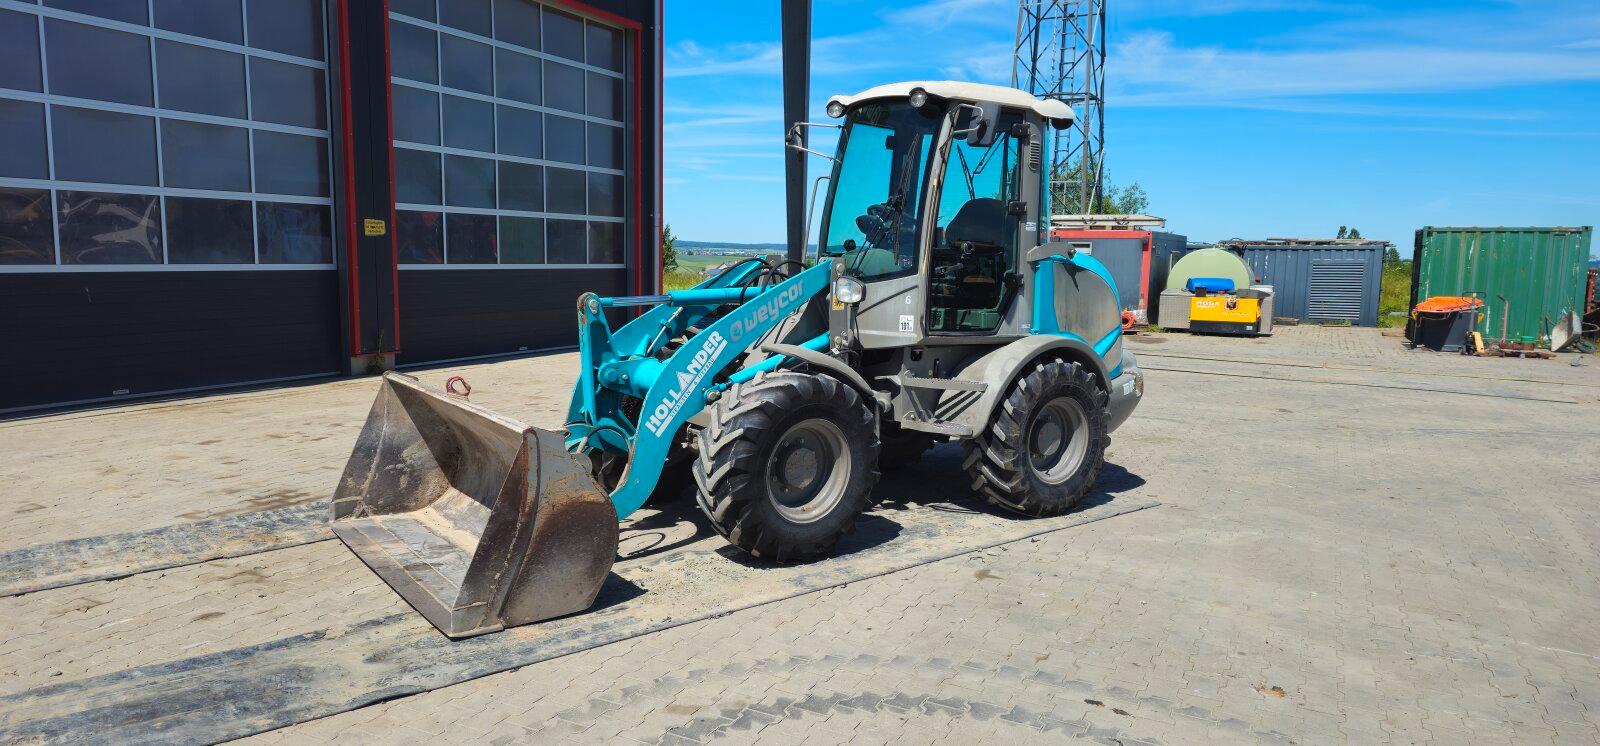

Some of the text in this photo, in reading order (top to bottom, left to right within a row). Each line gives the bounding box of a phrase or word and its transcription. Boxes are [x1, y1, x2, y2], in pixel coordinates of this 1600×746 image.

[743, 279, 804, 332] weycor
[905, 295, 912, 305] 6
[644, 330, 724, 433] HOLLANDER
